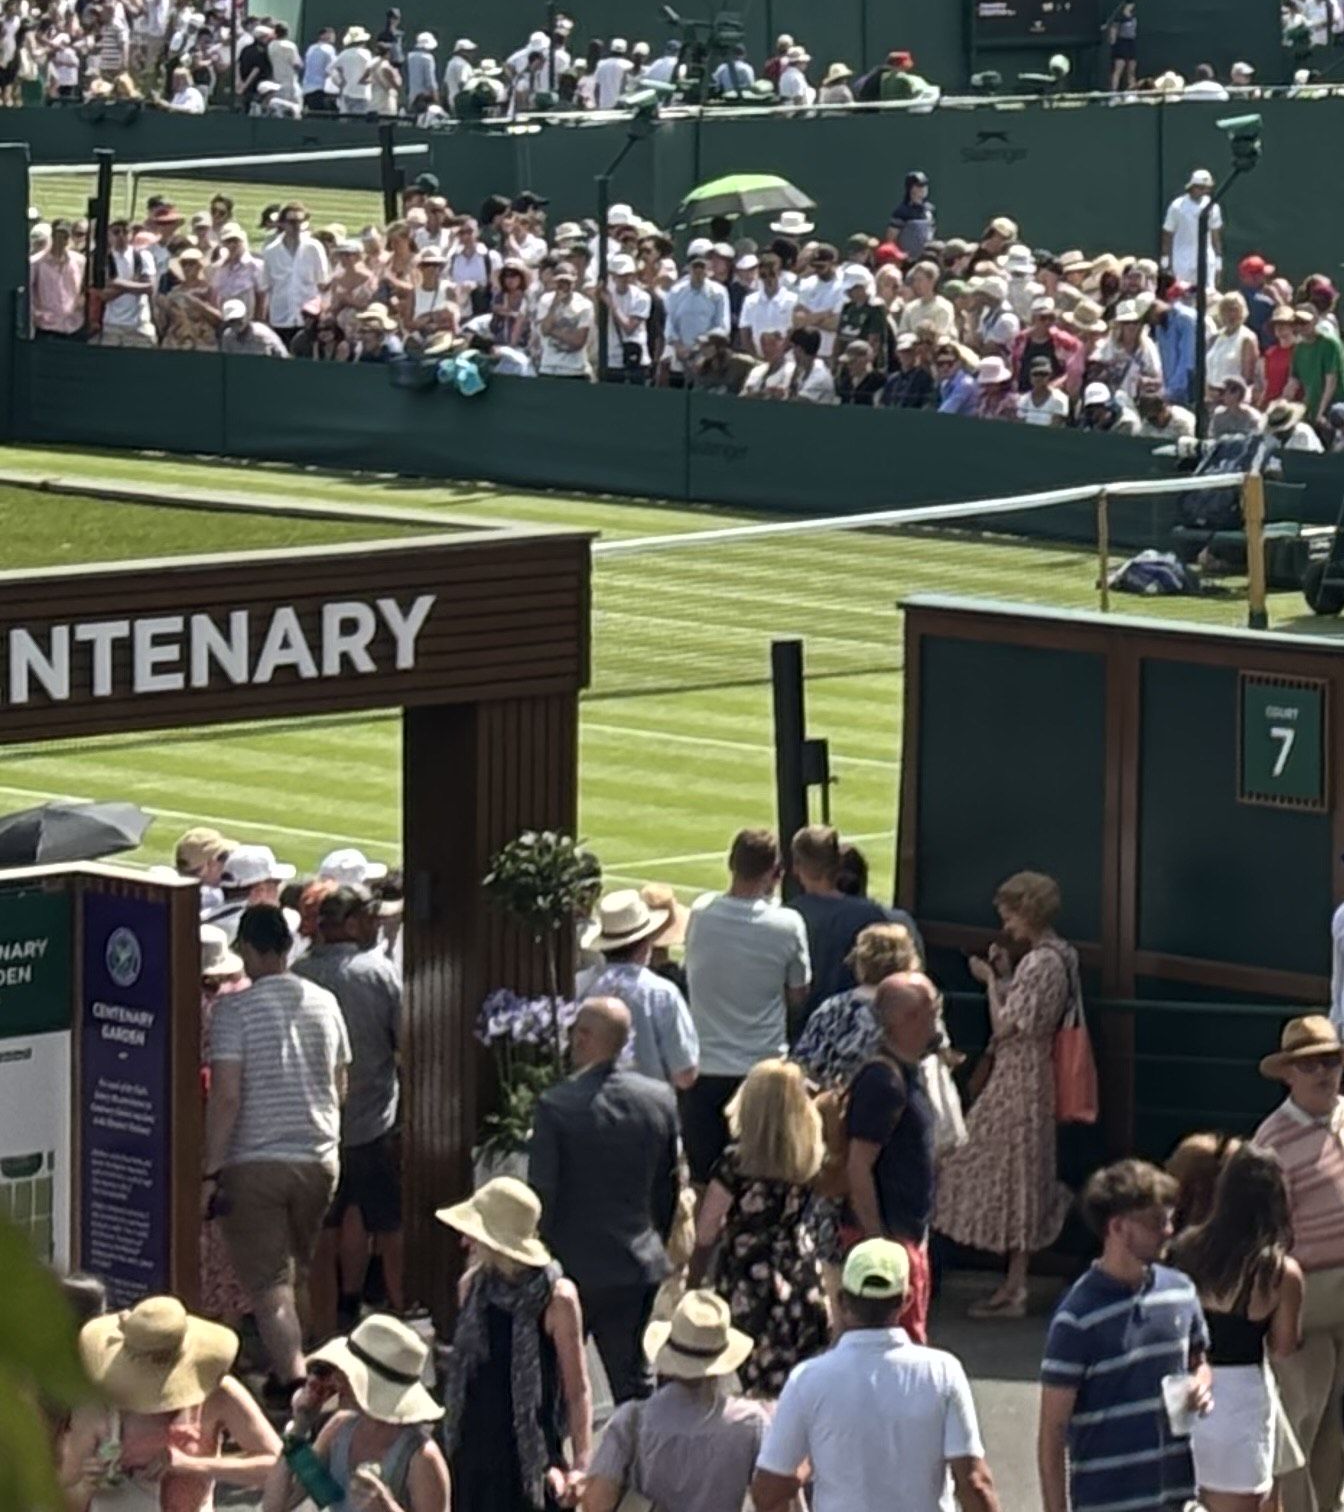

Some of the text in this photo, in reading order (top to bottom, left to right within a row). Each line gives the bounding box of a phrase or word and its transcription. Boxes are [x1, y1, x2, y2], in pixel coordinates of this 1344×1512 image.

[8, 594, 437, 705] NTENARY
[1265, 705, 1299, 721] COURT
[1270, 726, 1295, 778] 7
[0, 937, 49, 961] NARY
[92, 1001, 155, 1028] CENTENARY
[101, 1023, 146, 1046] GARDEN
